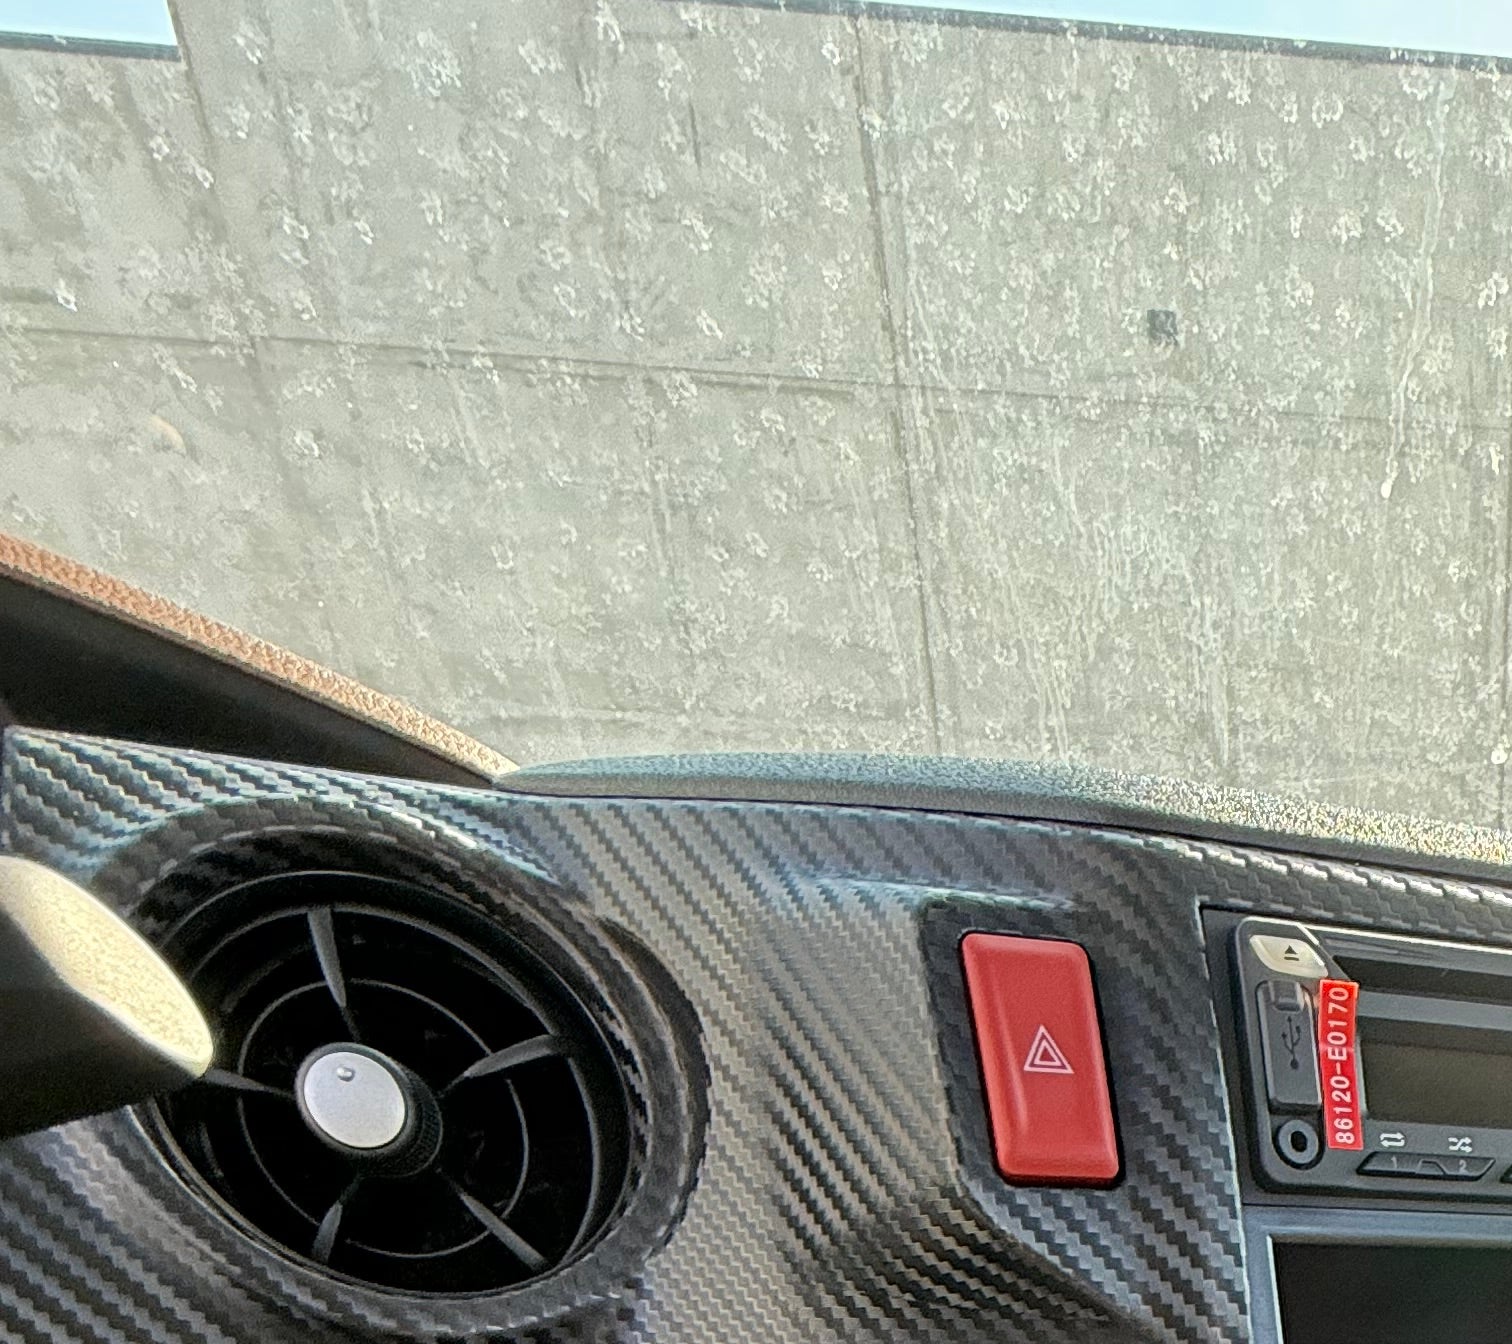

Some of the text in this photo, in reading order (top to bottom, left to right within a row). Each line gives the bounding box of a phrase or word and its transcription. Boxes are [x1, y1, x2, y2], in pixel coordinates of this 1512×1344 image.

[1327, 987, 1356, 1145] 86120-E0170
[1391, 1156, 1398, 1169] 1
[1459, 1159, 1468, 1174] 2
